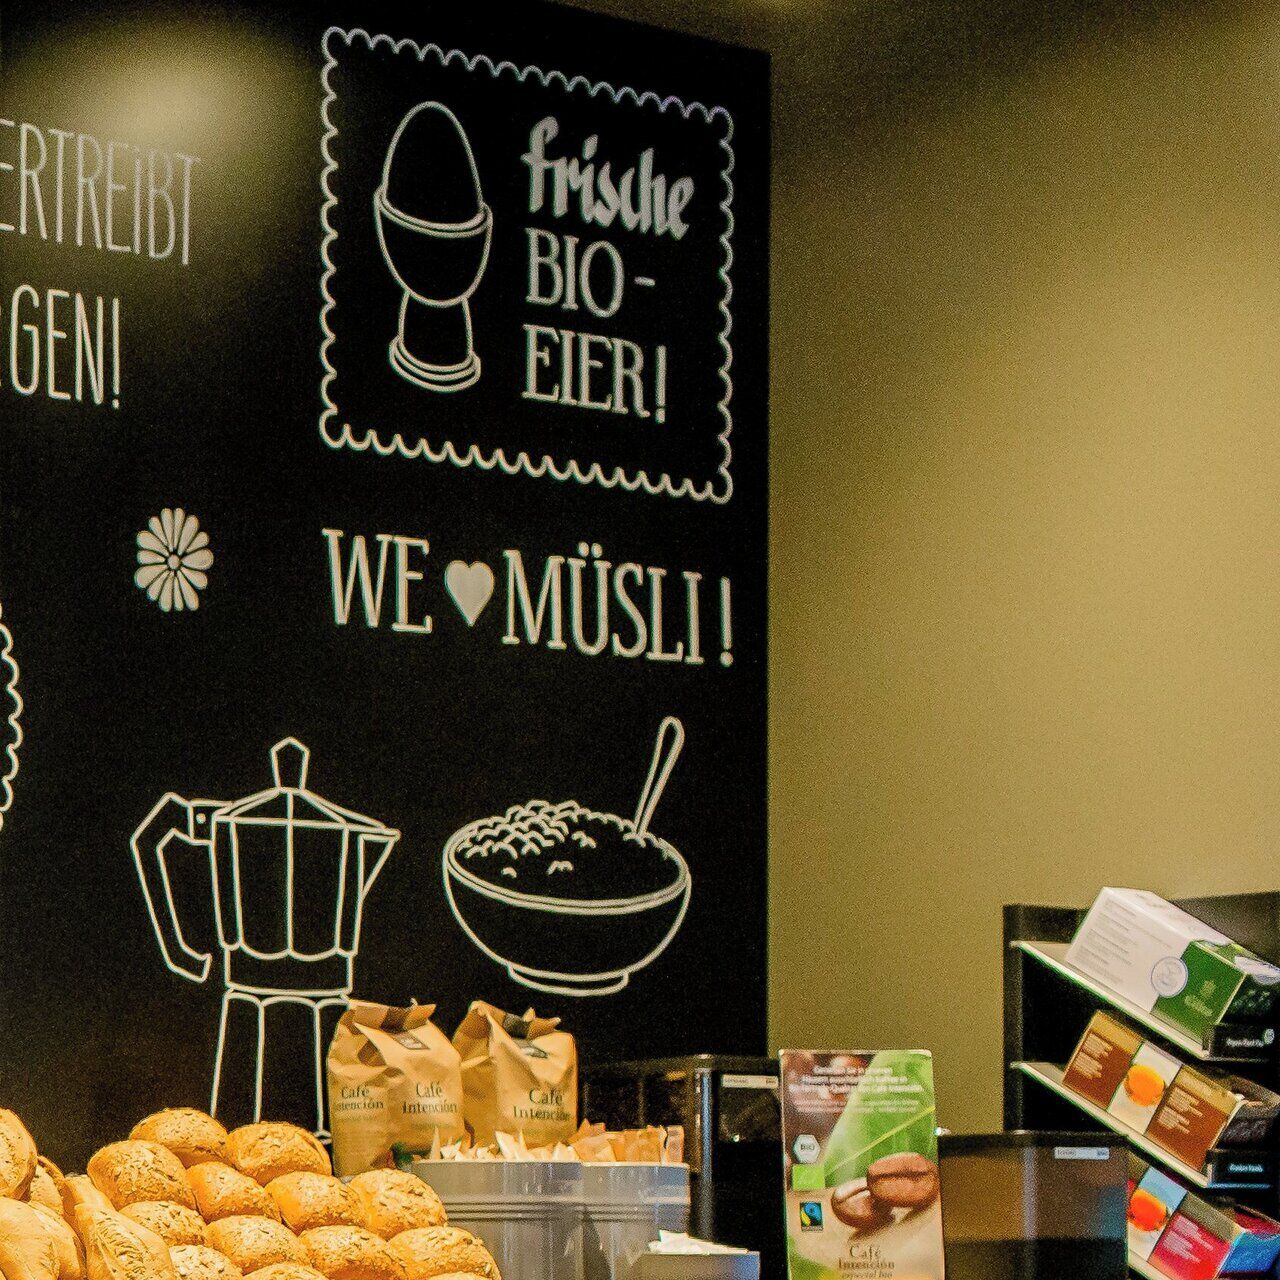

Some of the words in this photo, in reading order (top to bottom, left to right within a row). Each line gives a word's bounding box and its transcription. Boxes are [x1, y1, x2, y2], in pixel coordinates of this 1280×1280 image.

[522, 116, 695, 242] frische
[524, 228, 657, 319] BIO-
[522, 325, 668, 424] EIER!
[321, 528, 433, 637] WE
[501, 543, 735, 669] MÜSLI!
[528, 1086, 564, 1106] Café
[848, 1243, 882, 1258] Café
